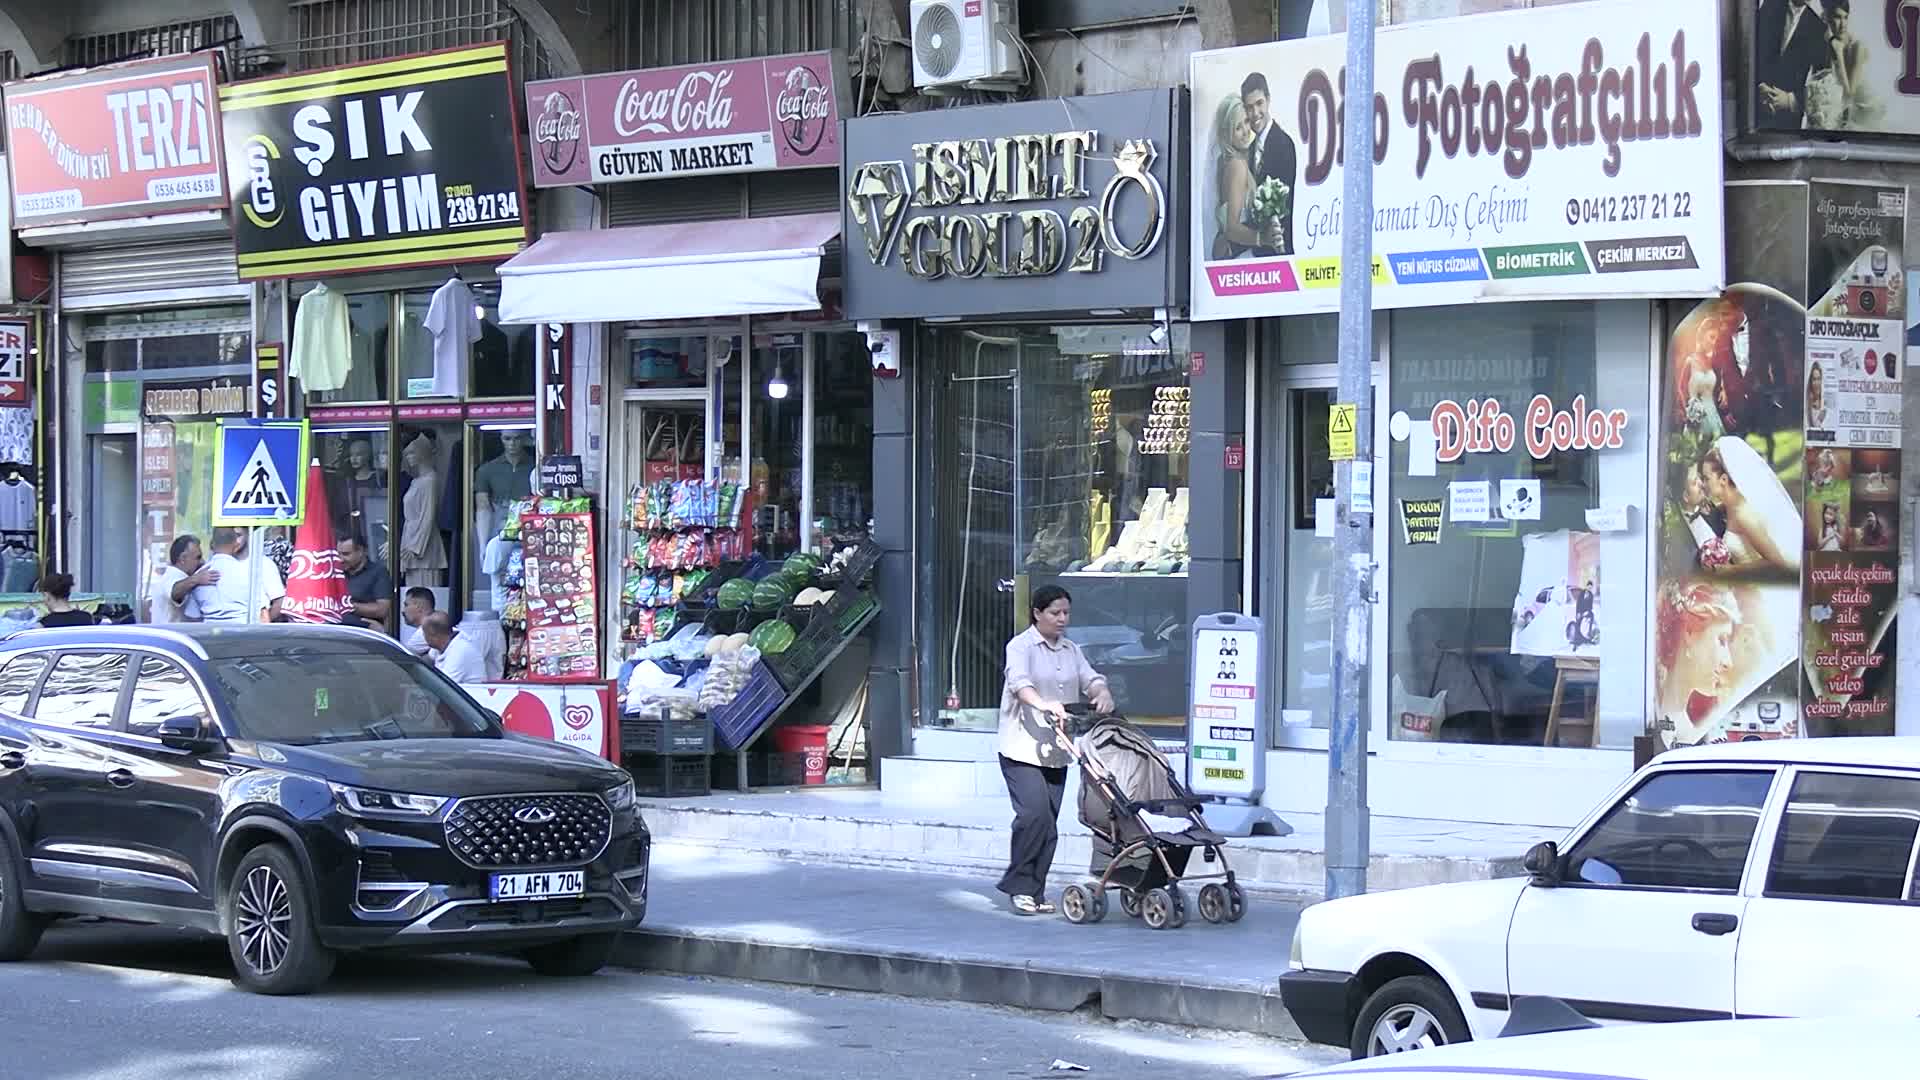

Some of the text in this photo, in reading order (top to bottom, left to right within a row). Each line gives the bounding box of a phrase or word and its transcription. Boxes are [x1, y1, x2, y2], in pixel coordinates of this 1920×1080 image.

[966, 5, 979, 13] TCL
[1403, 30, 1702, 178] Fotoğrafçılık
[293, 90, 432, 177] ŞIK
[600, 142, 754, 176] GÜVEN MARKET
[155, 179, 215, 197] 0536 465 45 88
[446, 192, 519, 224] 238 27 34
[1464, 185, 1529, 241] Çekimi
[1583, 191, 1692, 224] 0412 237 21 22
[1496, 249, 1576, 270] BİOMETRİK
[1597, 241, 1686, 268] ÇEKİM MERKEZİ
[1217, 269, 1281, 288] VESİKALIK
[1431, 394, 1628, 462] Difo Color
[1844, 564, 1859, 584] dış
[1861, 564, 1892, 584] çekim
[1836, 608, 1858, 624] aile
[1831, 628, 1864, 645] nişan
[1816, 650, 1882, 671] özel günler
[1829, 675, 1861, 692] video
[1806, 697, 1841, 716] çekim
[562, 733, 593, 742] ALGIDA
[500, 872, 582, 896] 21 AFN 704
